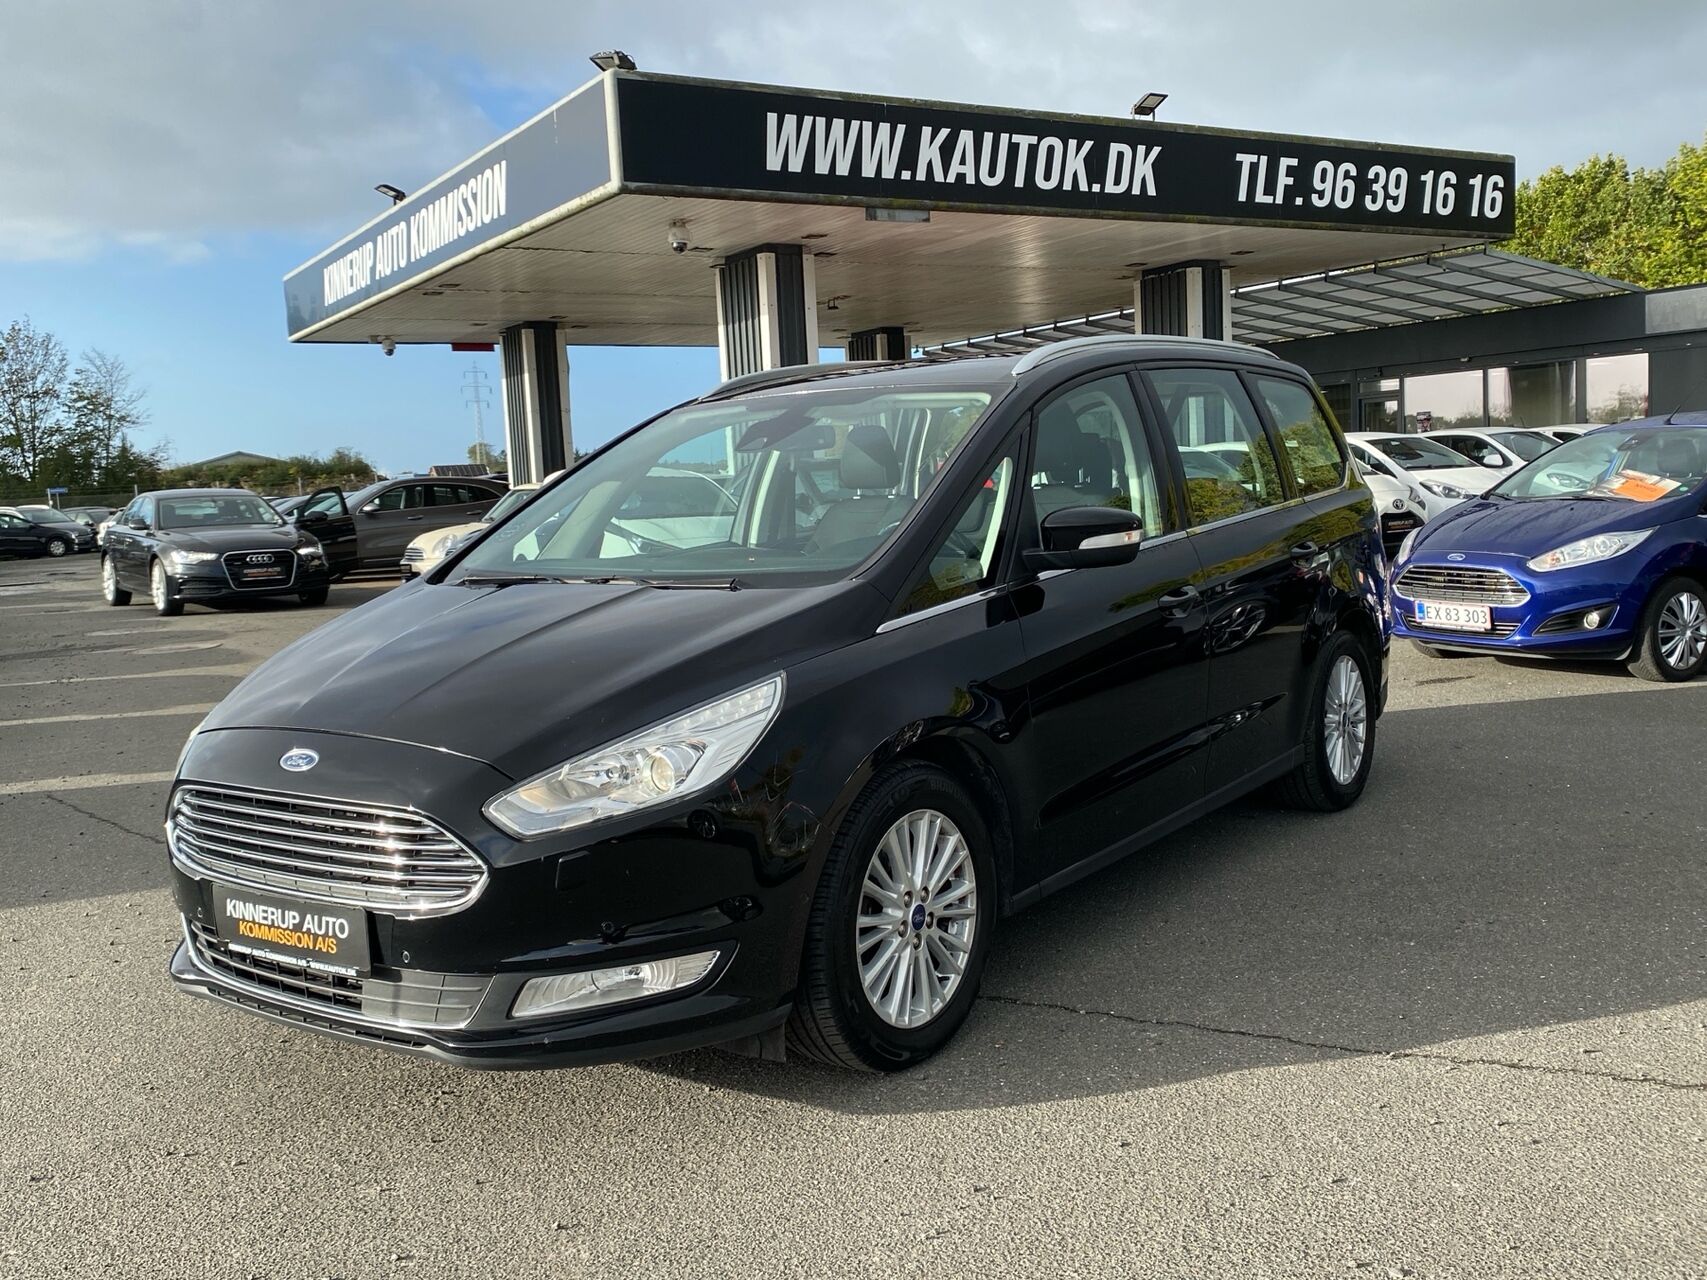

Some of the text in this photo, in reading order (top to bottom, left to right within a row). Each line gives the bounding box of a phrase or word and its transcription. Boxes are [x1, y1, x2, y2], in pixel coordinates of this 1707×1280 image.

[766, 112, 1162, 196] WWW.KAUTOK.DK
[1235, 153, 1505, 219] TLF. 96 39 16 16
[323, 160, 507, 306] KINNERUP AUTO KOMMISSION
[1426, 605, 1487, 624] EX 83 303
[226, 898, 349, 939] KINNERUP AUTO
[239, 920, 337, 954] KOMMISSION A/S
